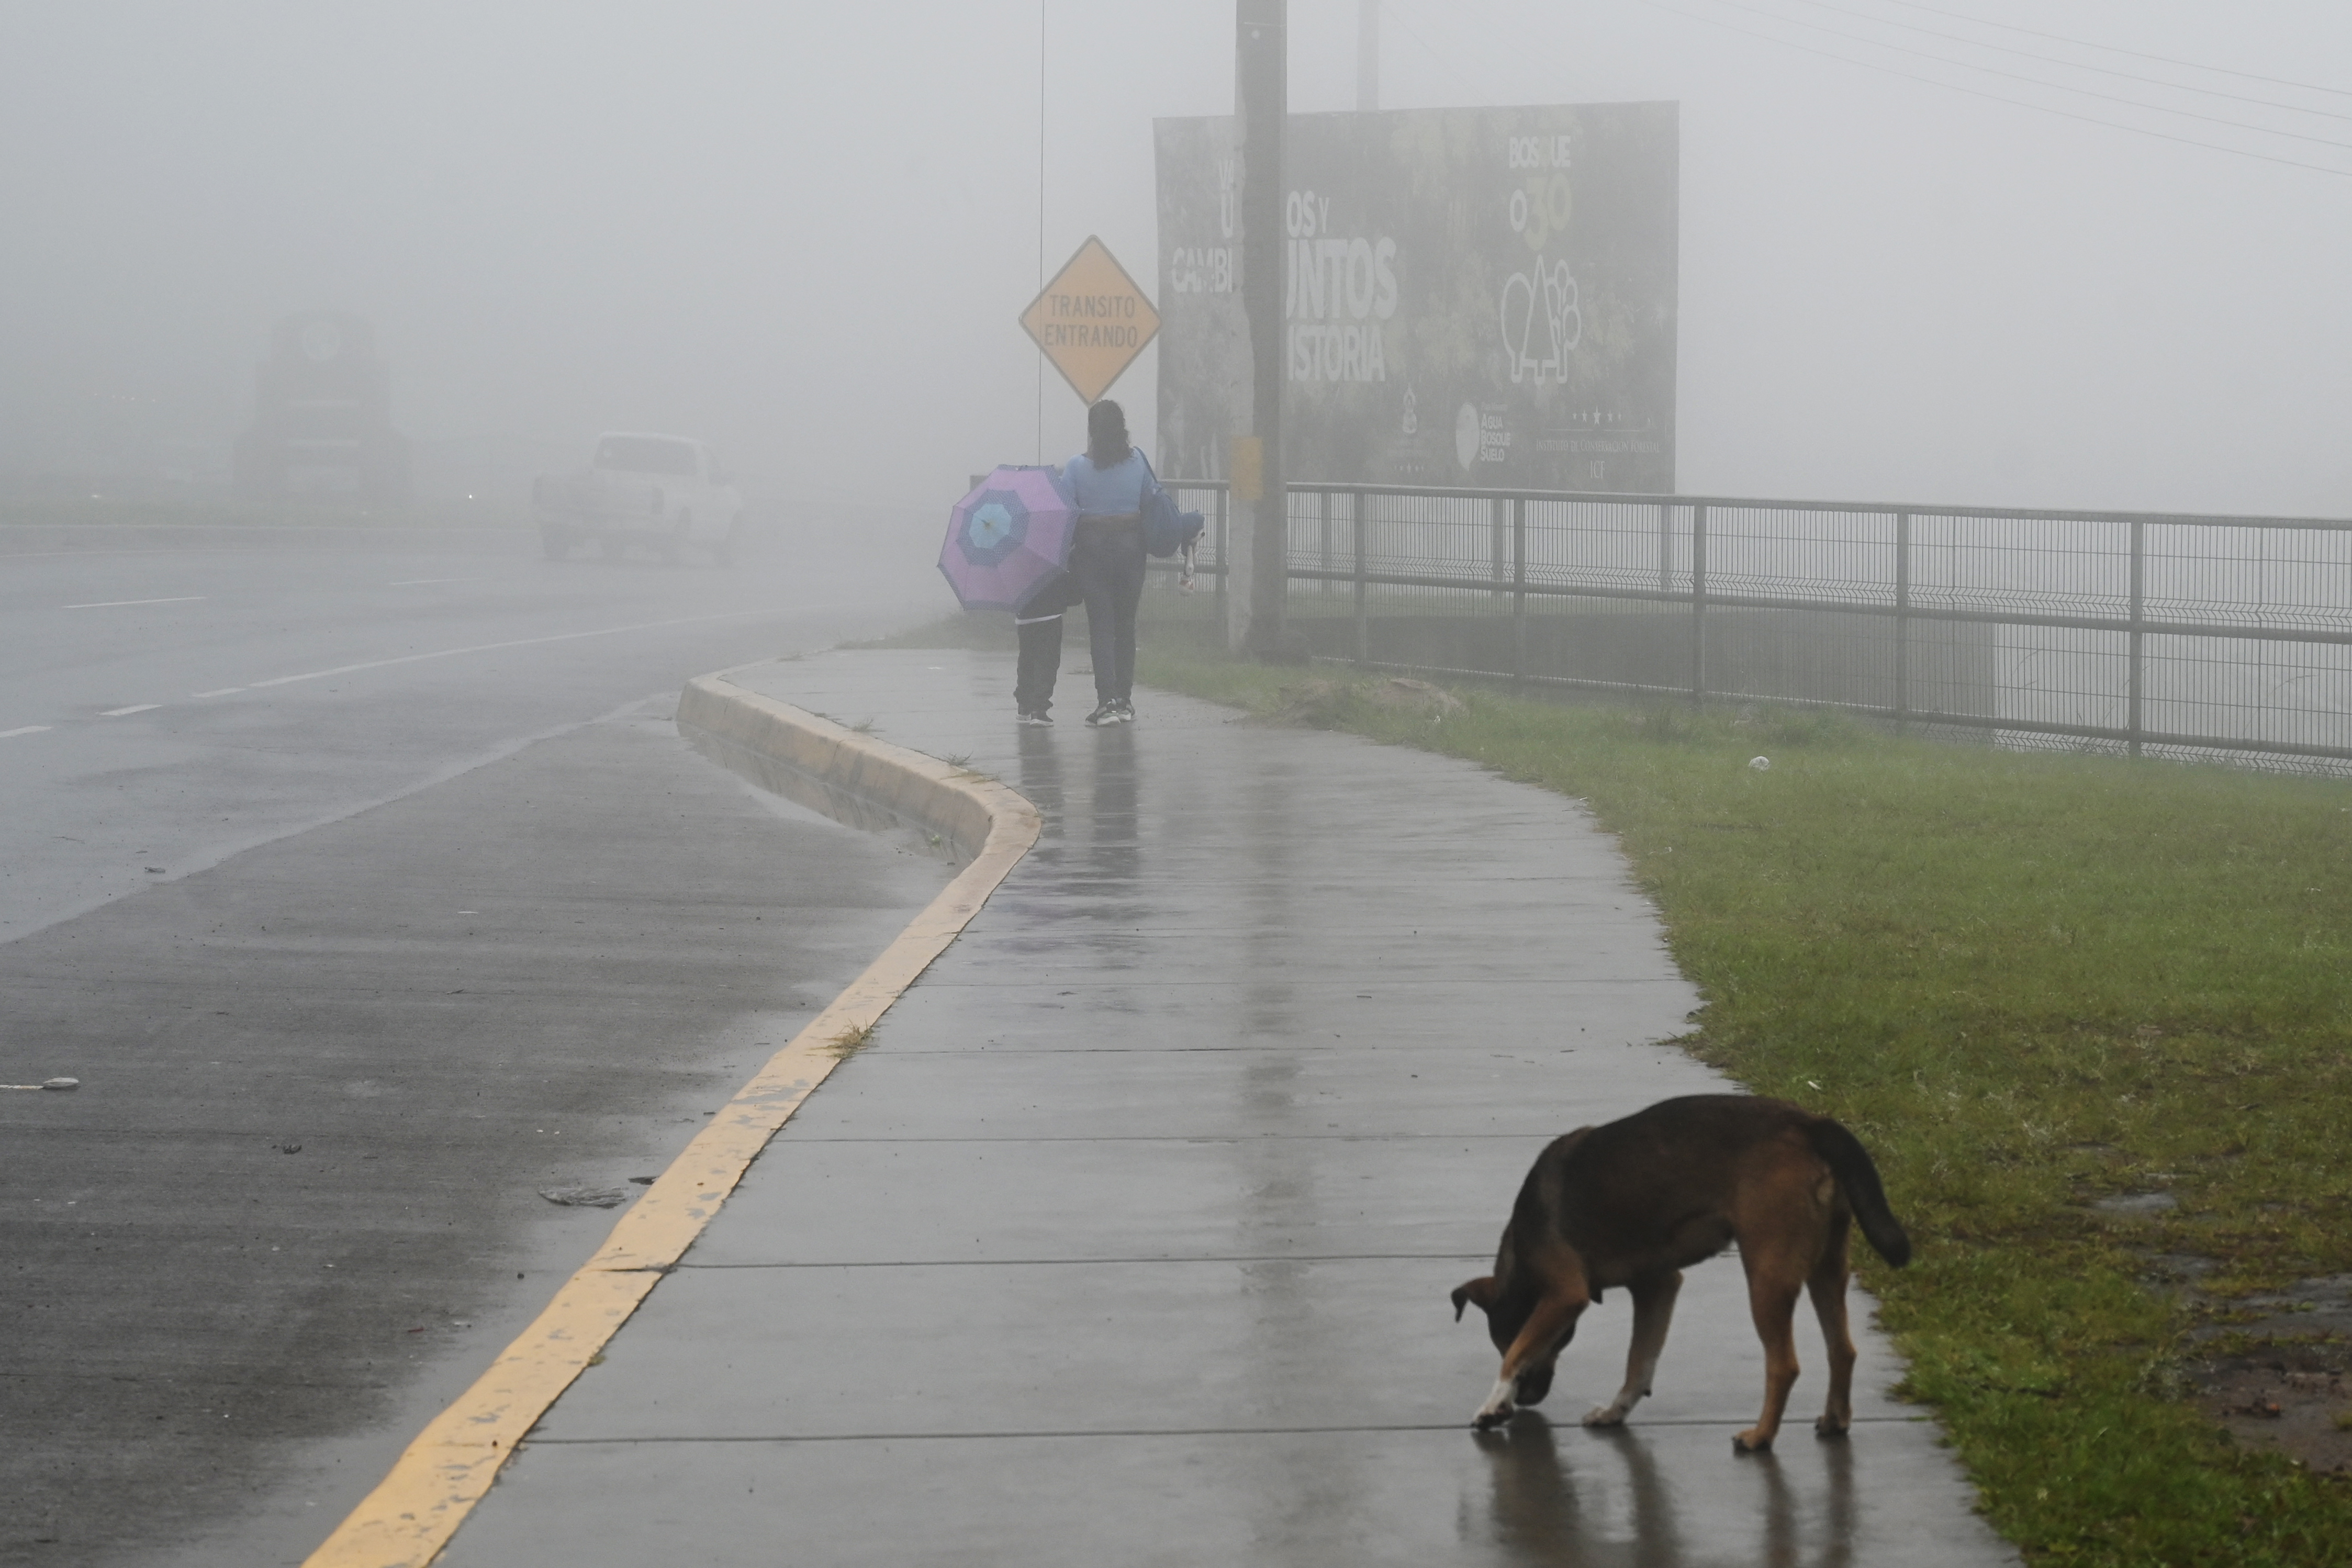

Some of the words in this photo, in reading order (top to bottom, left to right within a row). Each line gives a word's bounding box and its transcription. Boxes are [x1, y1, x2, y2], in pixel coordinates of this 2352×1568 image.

[1318, 197, 1330, 234] Y
[1049, 295, 1136, 319] TRANSITO
[1045, 323, 1138, 348] ENTRANDO
[1481, 413, 1504, 430] AGUA
[1481, 429, 1511, 447] BOSQUE
[1536, 439, 1569, 452] INSTITUTO
[1630, 440, 1661, 453] FORESTAL
[1481, 445, 1505, 462] SUELO
[1590, 460, 1606, 479] ICF
